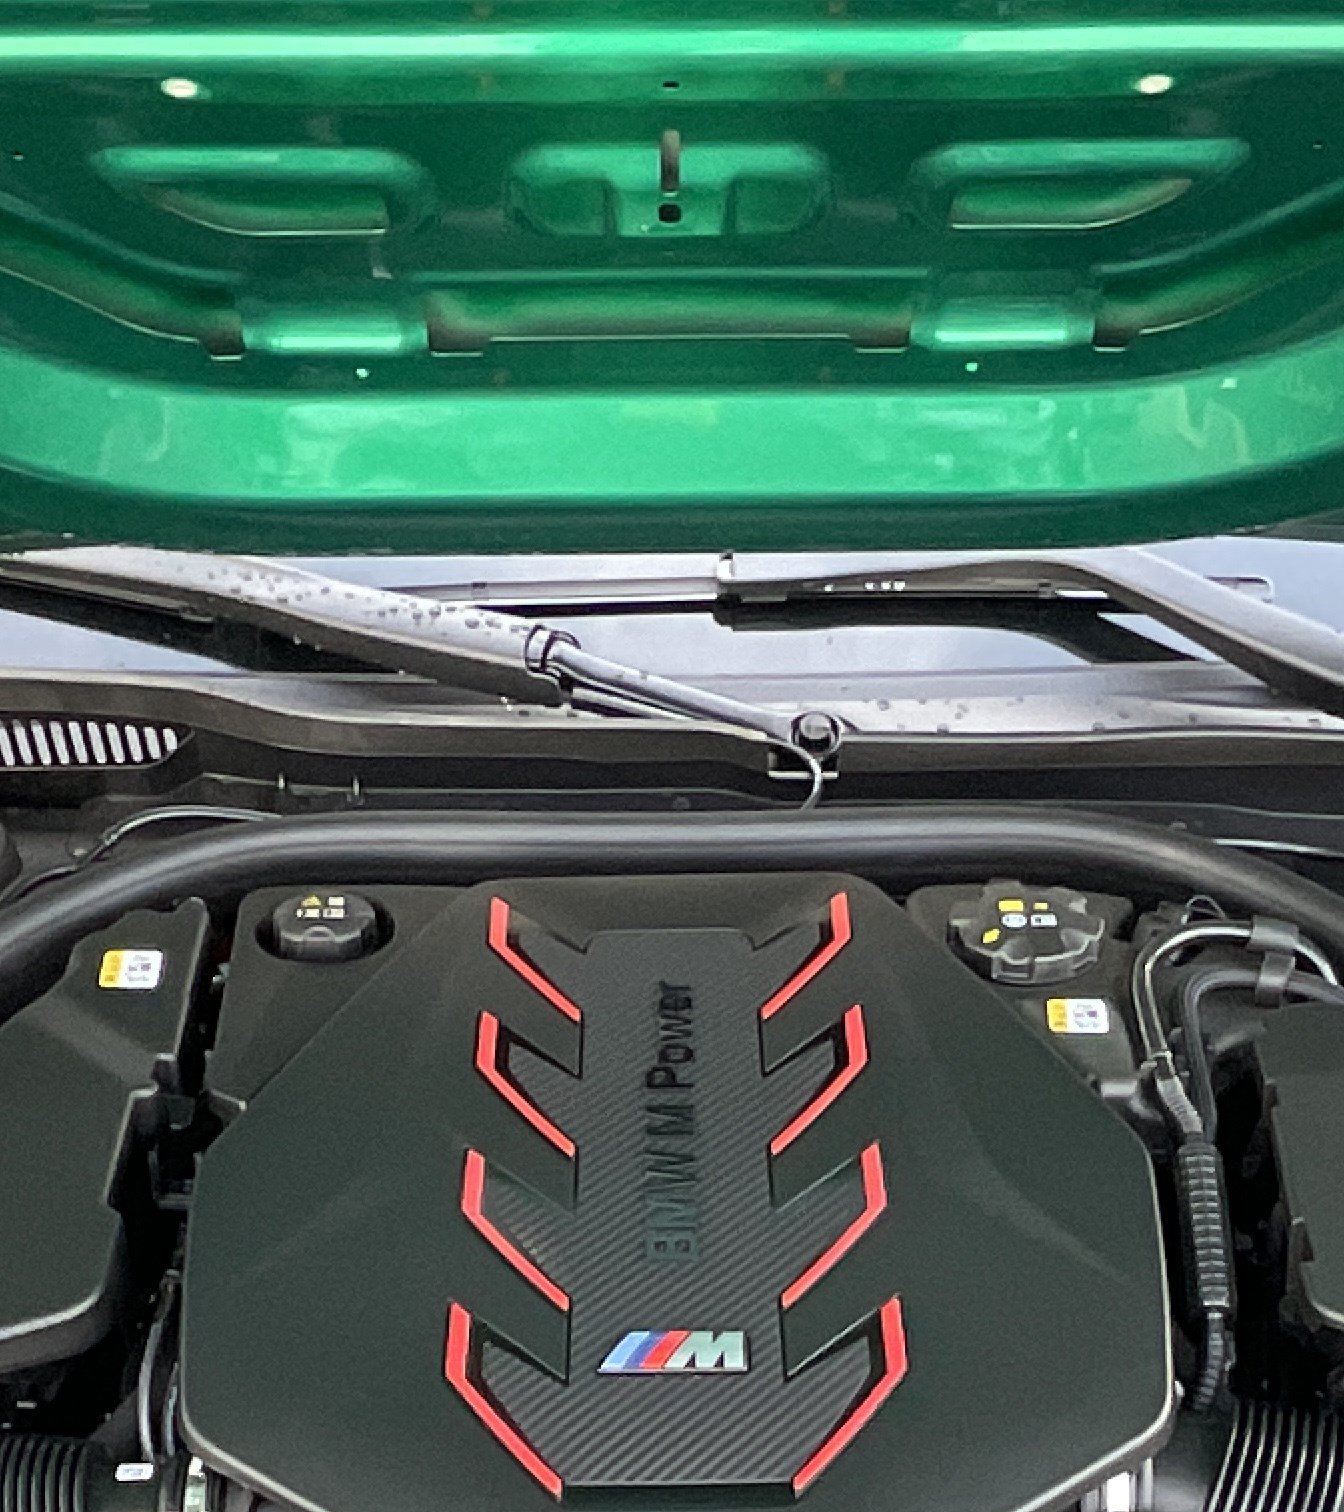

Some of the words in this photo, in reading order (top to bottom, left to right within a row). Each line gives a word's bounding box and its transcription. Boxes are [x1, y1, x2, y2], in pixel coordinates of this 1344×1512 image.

[646, 980, 695, 1089] Power
[645, 1103, 694, 1136] M
[645, 1149, 698, 1260] BMW
[660, 1329, 749, 1373] M
